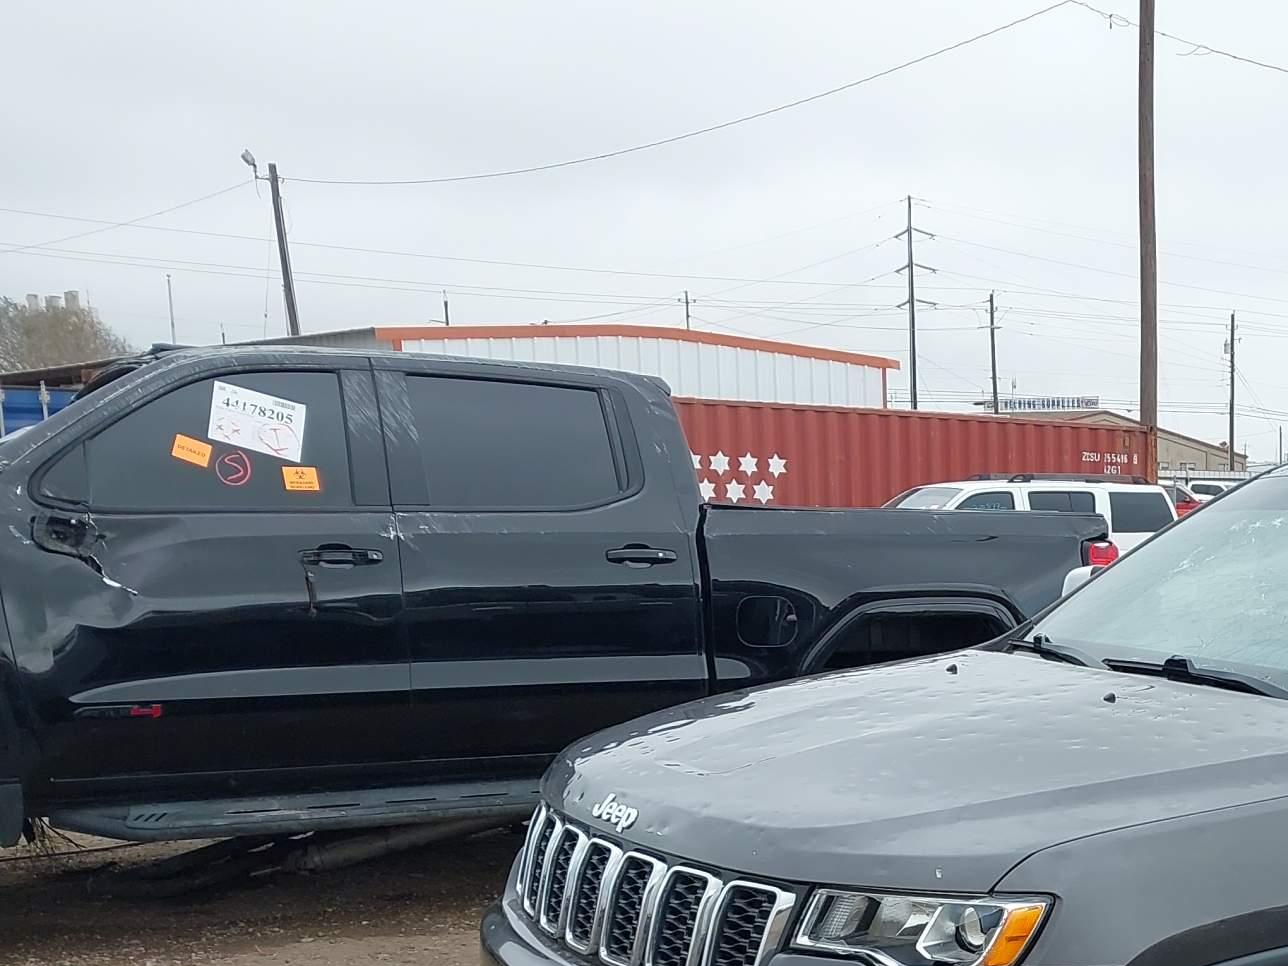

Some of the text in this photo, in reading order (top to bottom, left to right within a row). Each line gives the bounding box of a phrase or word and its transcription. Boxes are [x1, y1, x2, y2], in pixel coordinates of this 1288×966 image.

[222, 397, 293, 425] 44178205
[1041, 397, 1081, 409] SUPPLIES
[592, 793, 639, 833] Jeep
